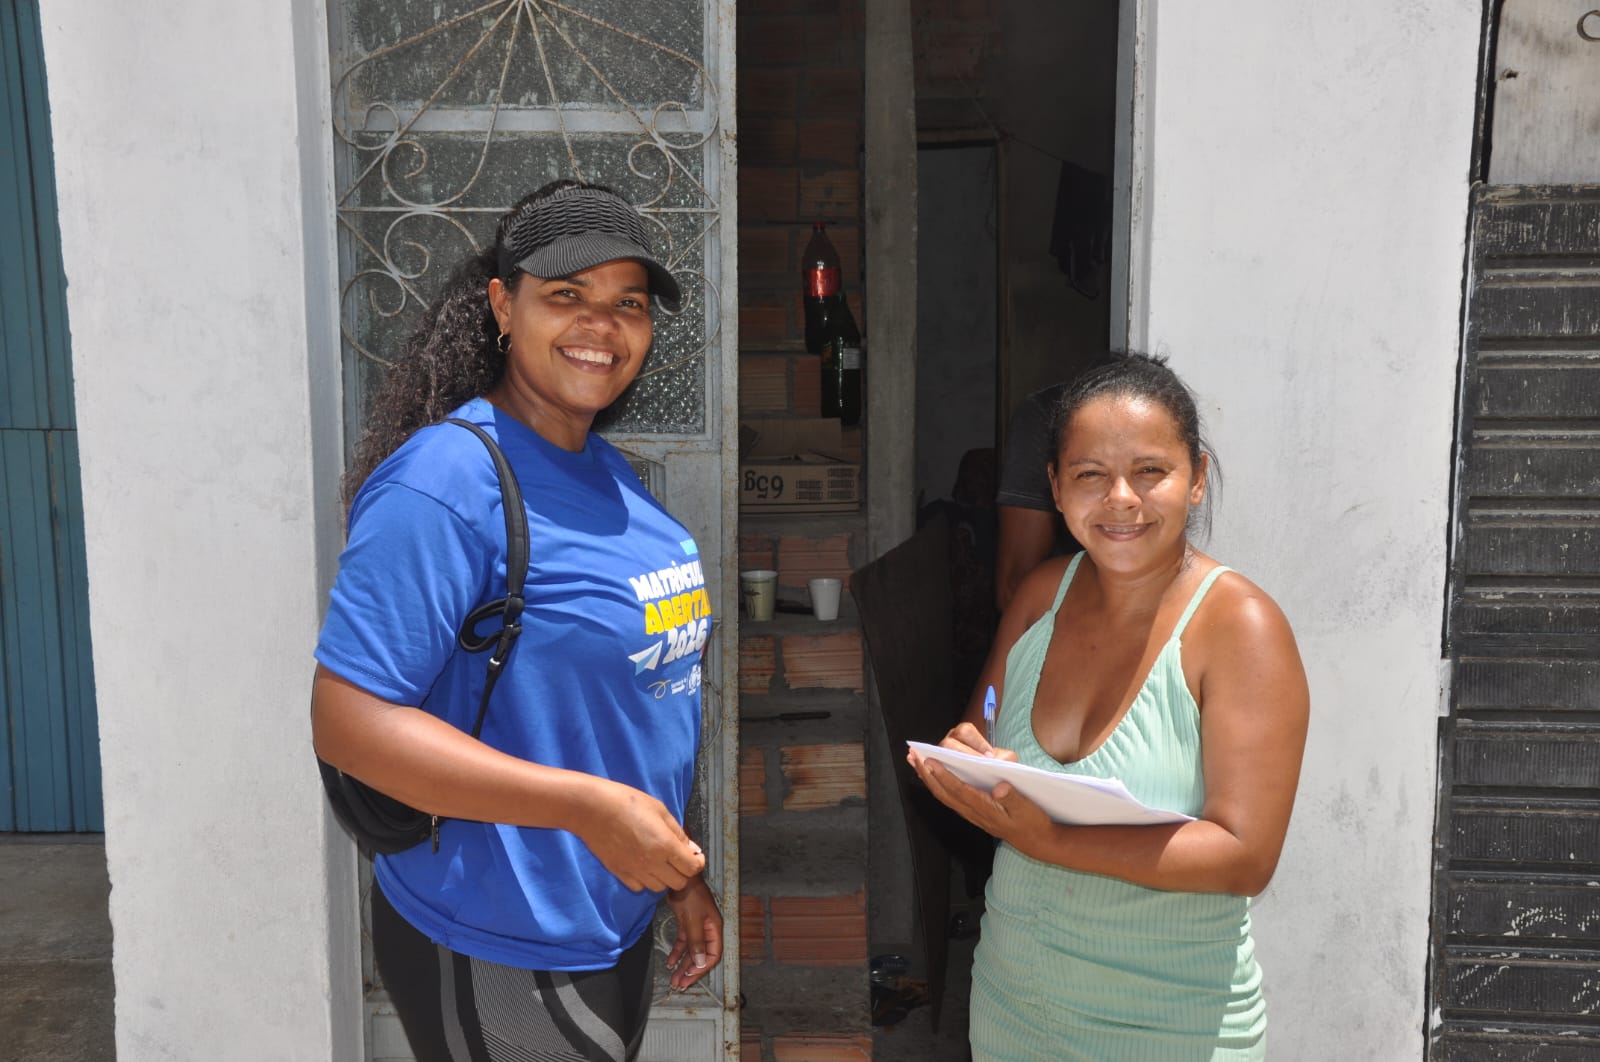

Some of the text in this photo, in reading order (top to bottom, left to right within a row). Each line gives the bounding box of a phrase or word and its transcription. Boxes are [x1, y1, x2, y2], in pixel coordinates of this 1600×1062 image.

[744, 470, 784, 498] 65g
[628, 560, 704, 601] MATRÍCUL
[662, 618, 708, 664] 2026
